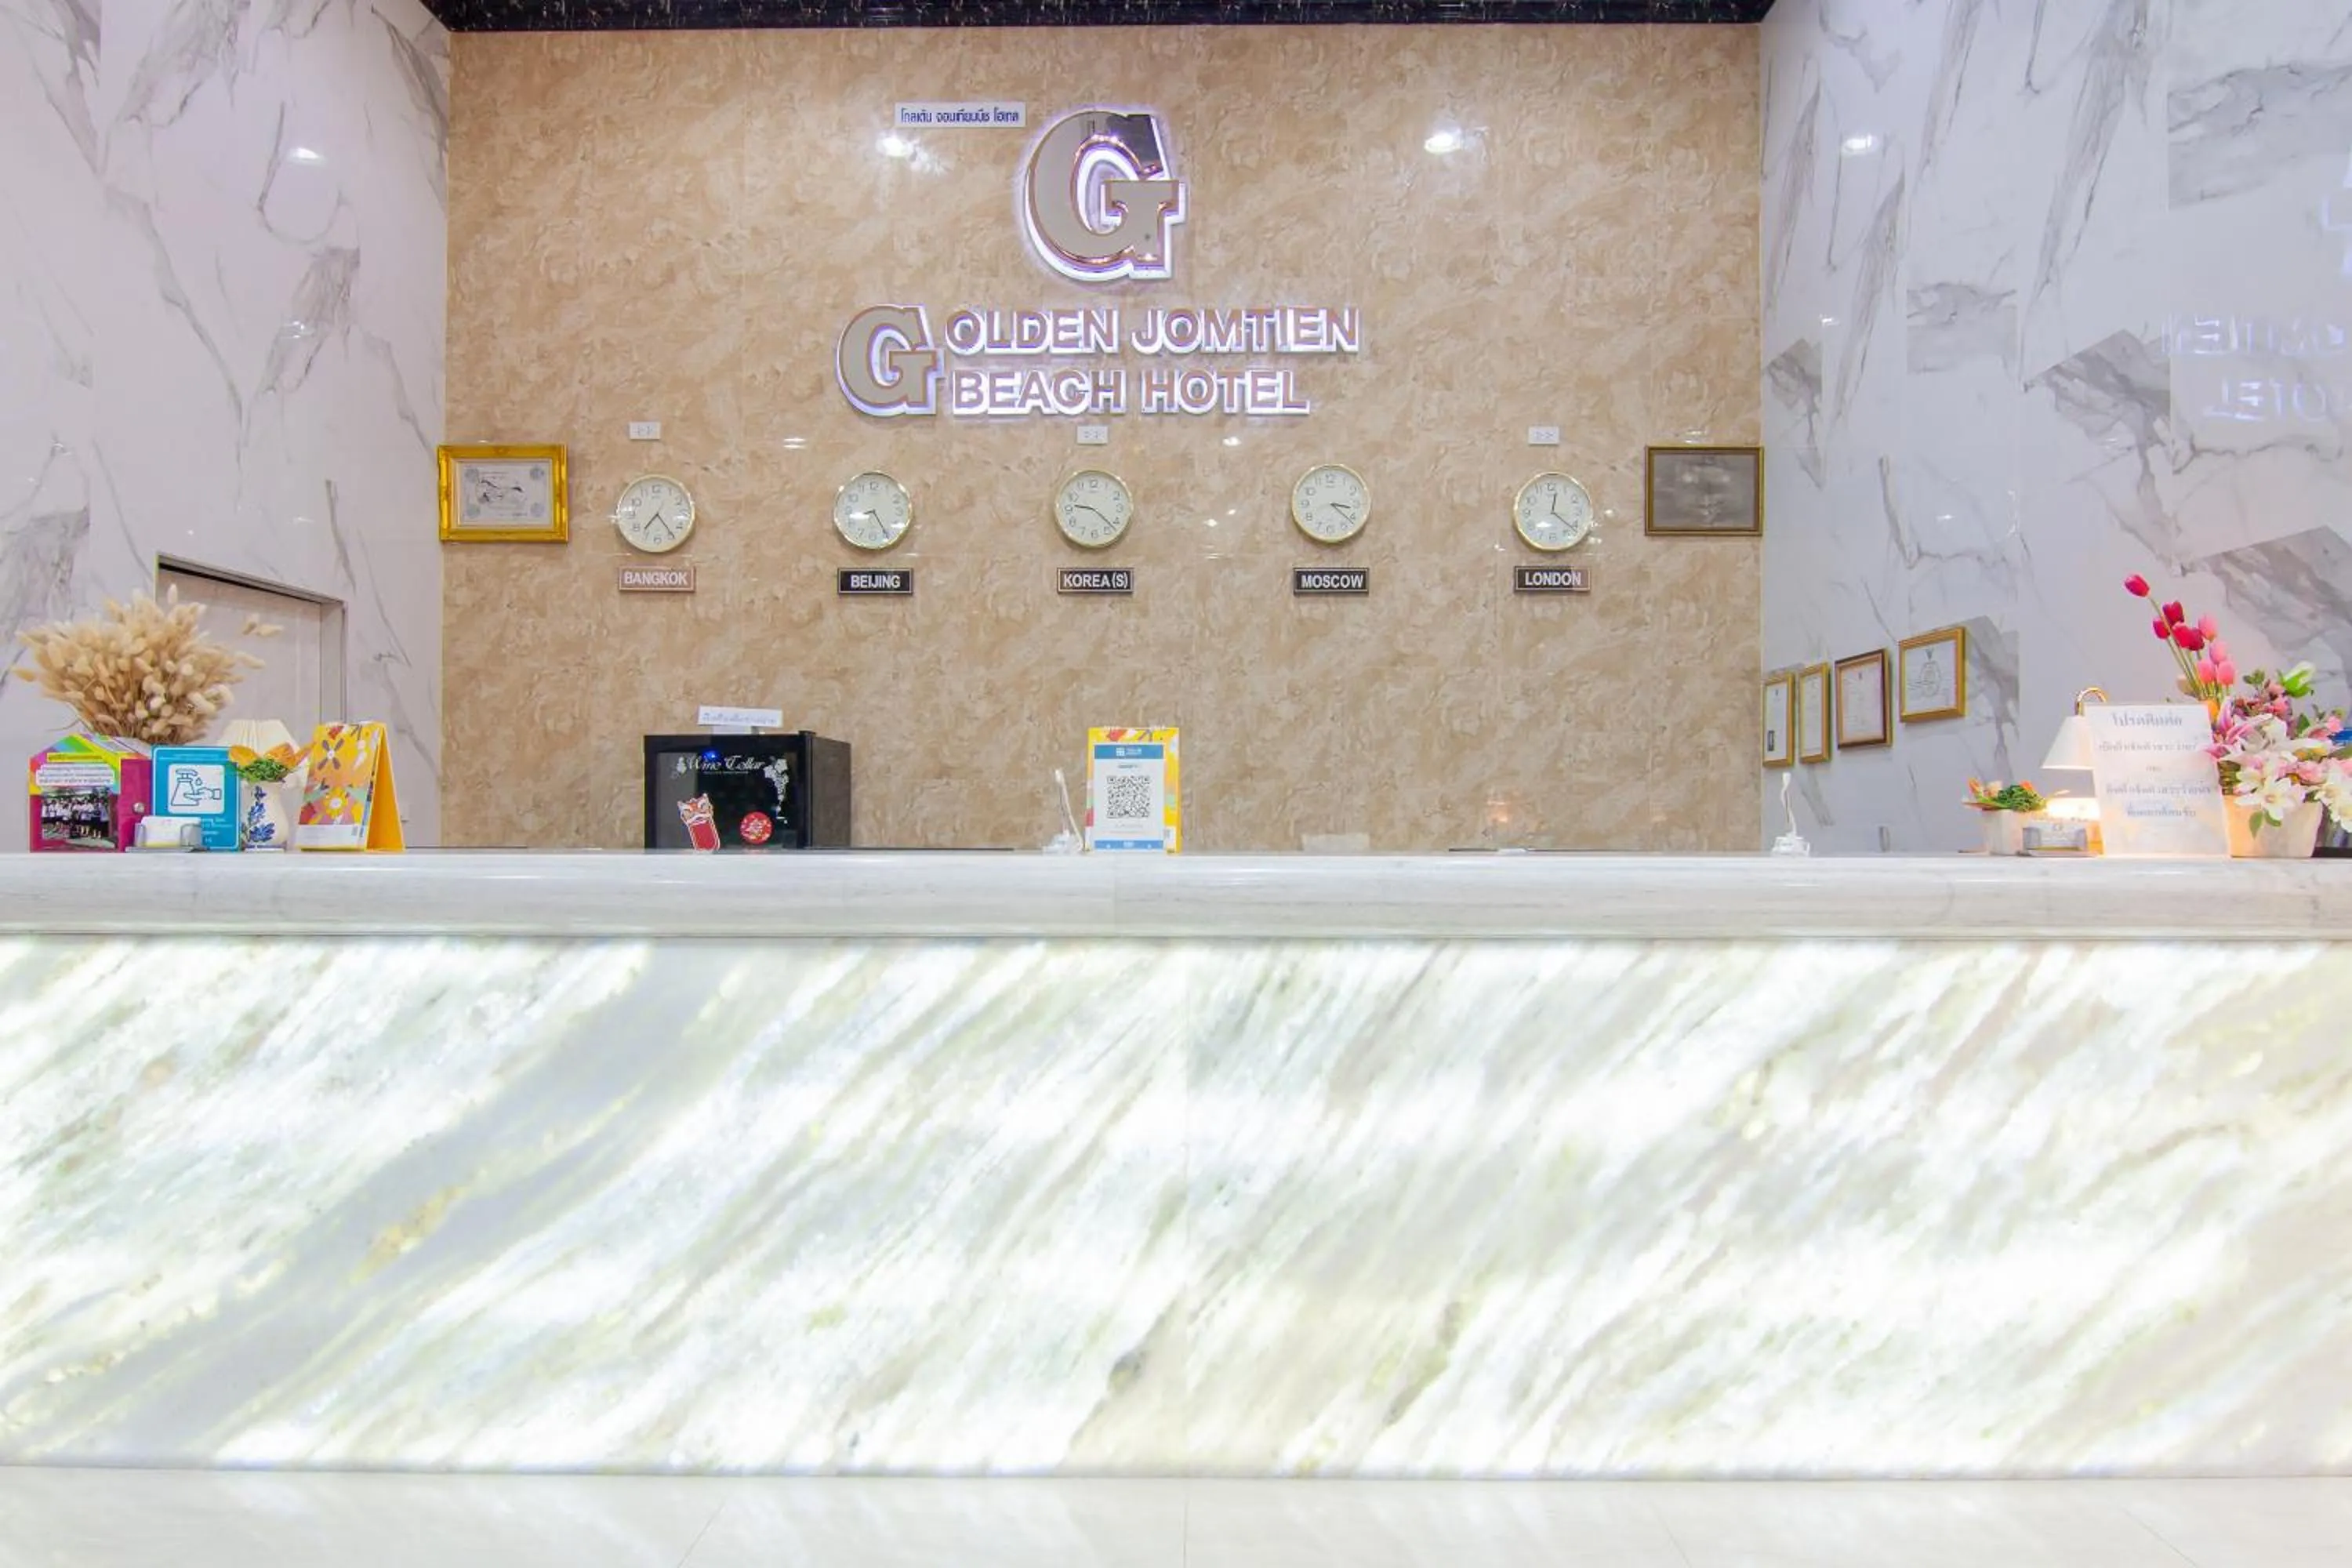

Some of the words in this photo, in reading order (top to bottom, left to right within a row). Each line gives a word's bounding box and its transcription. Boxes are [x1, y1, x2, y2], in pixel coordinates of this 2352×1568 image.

[1025, 110, 1186, 281] G
[1131, 307, 1359, 354] JOMTIEN
[953, 369, 1126, 415] BEACH
[1142, 369, 1310, 415] HOTEL
[624, 572, 688, 586] BANGKOK
[850, 575, 901, 588] BEIJING
[1301, 574, 1364, 589] MOSCOW
[1524, 571, 1582, 587] LONDON
